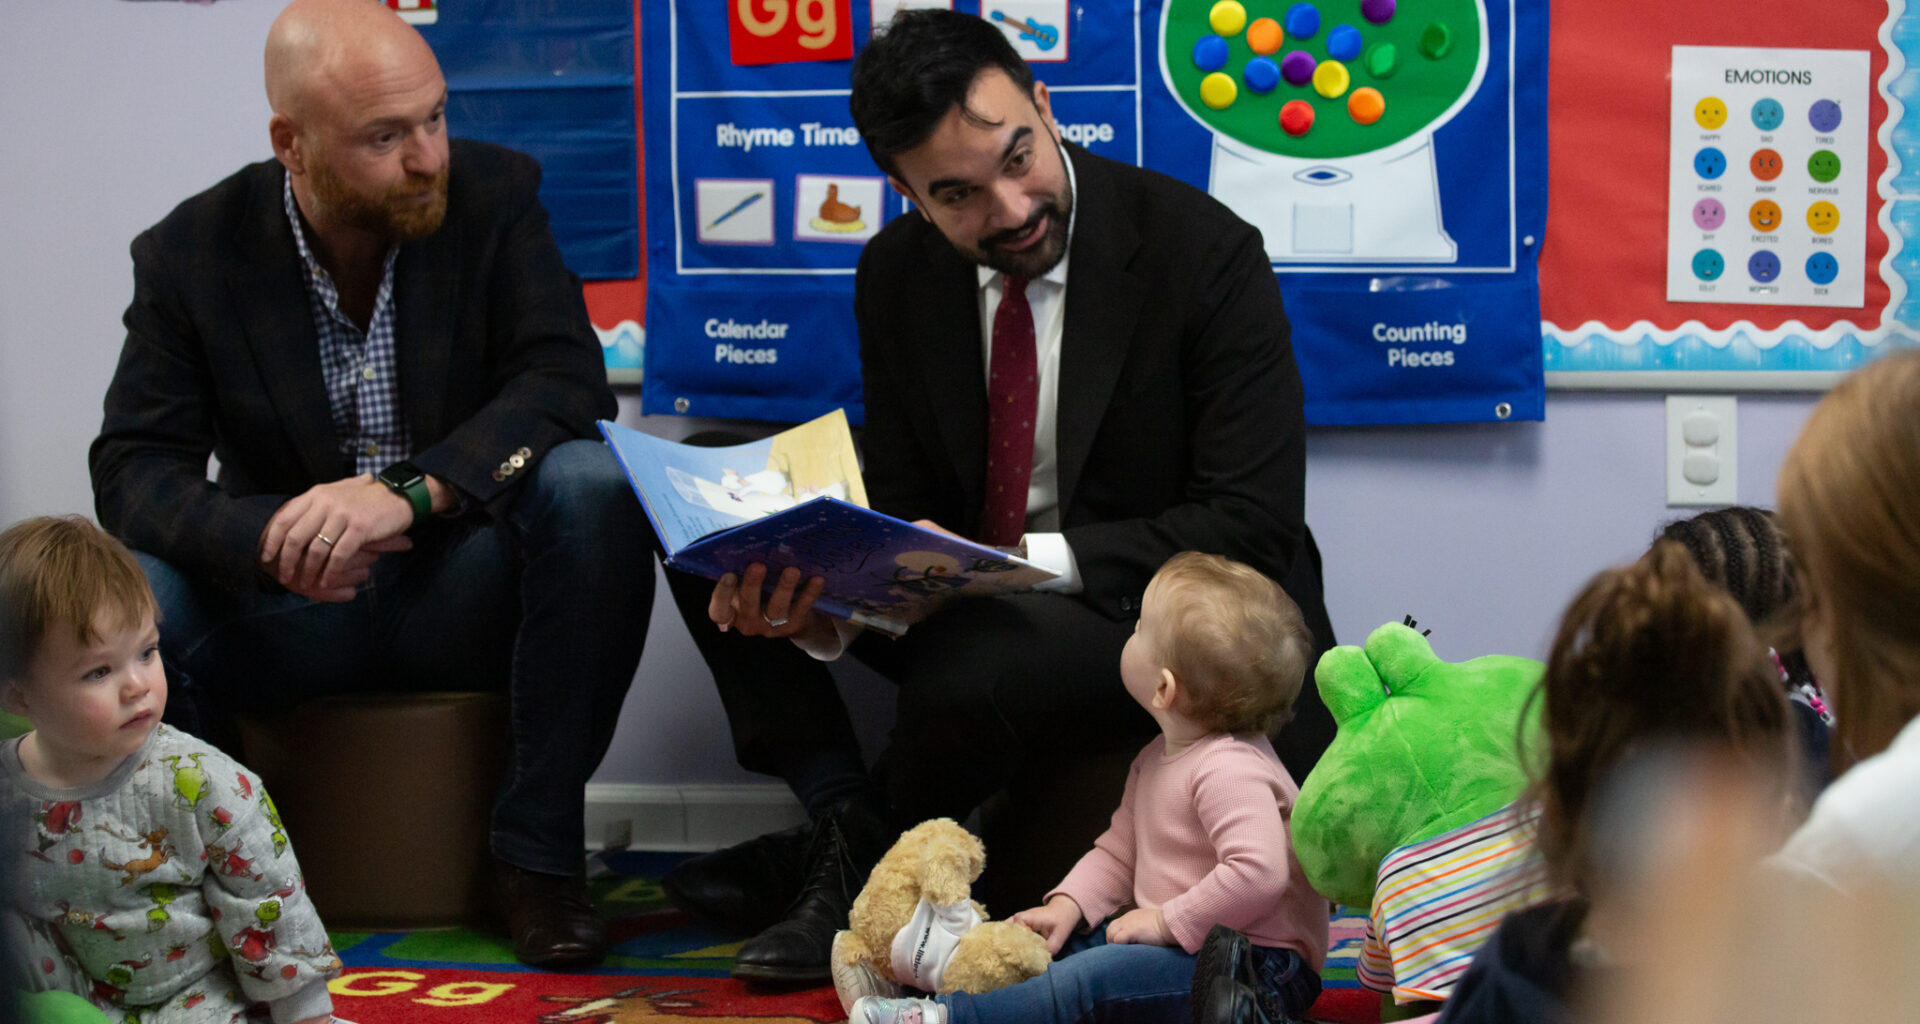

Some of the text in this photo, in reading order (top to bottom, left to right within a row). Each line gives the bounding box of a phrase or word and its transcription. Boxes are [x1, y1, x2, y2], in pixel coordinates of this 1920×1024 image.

[738, 0, 837, 49] Gg
[1725, 69, 1812, 85] EMOTIONS
[716, 122, 860, 152] Rhyme Time
[704, 318, 788, 340] Calendar
[1372, 321, 1467, 346] Counting
[715, 344, 777, 365] Pieces
[1388, 347, 1455, 367] Pieces
[327, 971, 517, 1007] Gg
